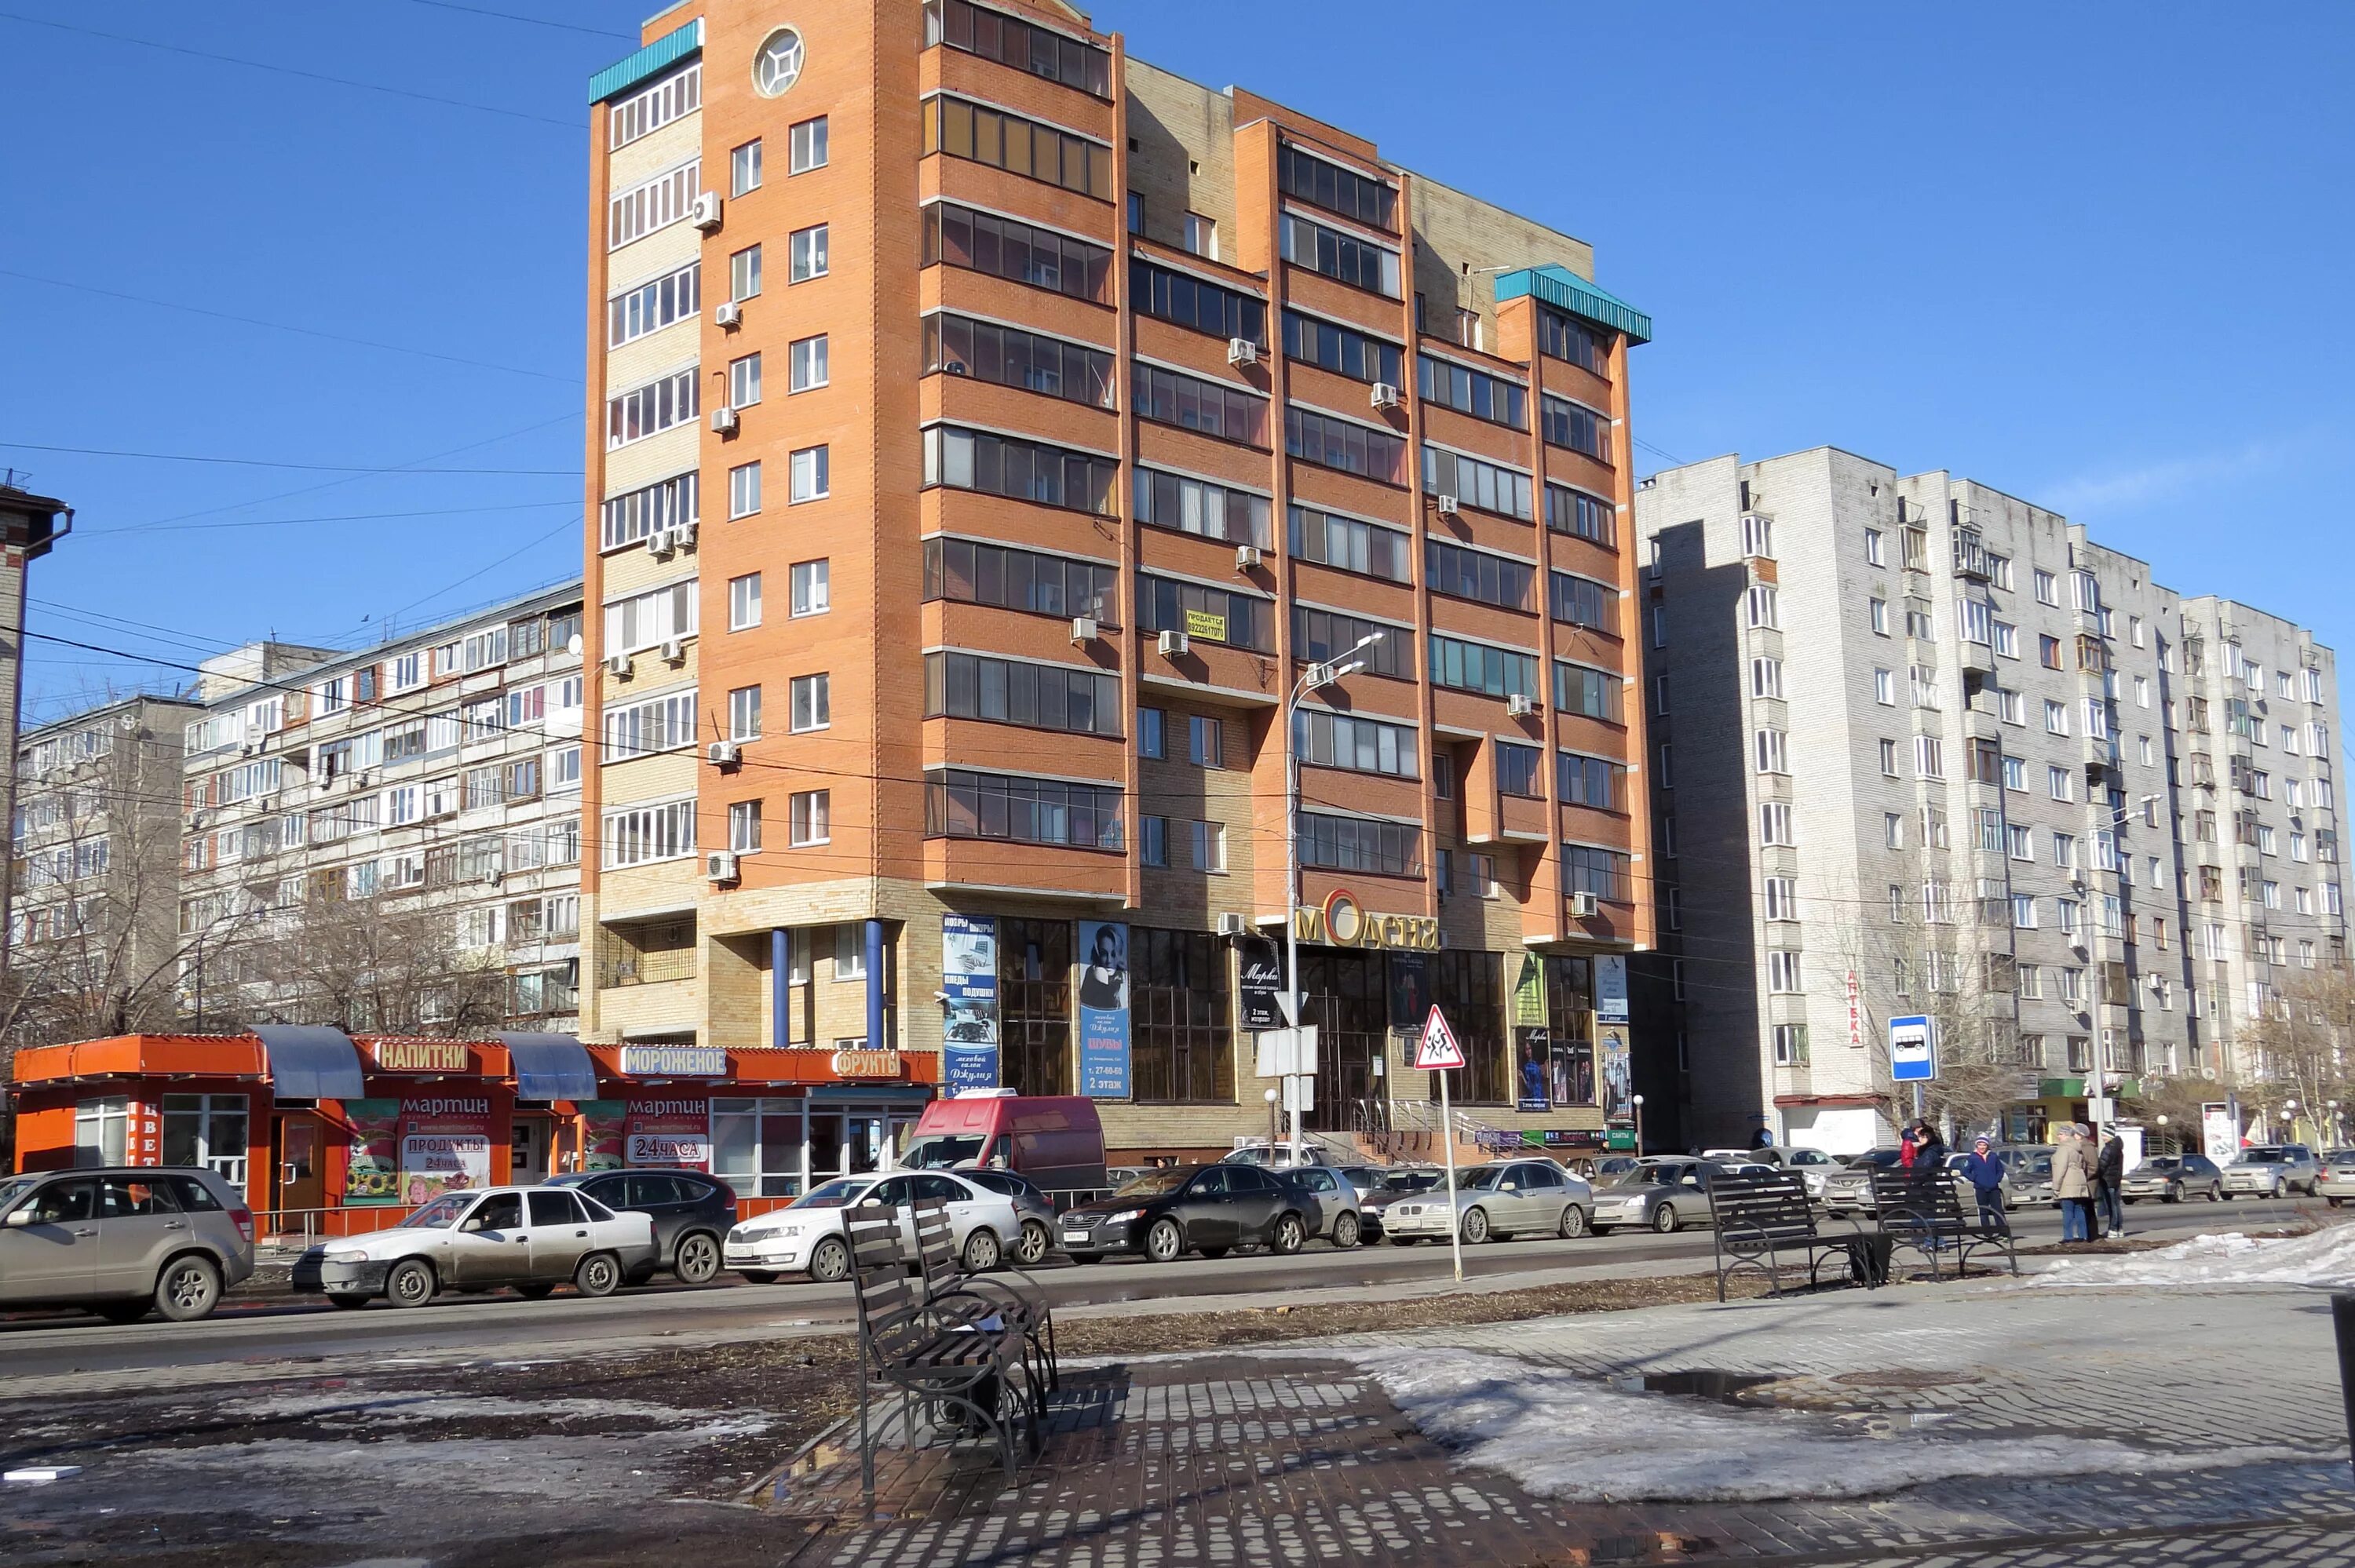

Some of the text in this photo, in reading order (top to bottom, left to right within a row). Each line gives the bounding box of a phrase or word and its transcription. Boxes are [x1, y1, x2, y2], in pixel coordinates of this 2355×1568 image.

[1188, 613, 1224, 625] ПРОДАЕТСЯ
[944, 975, 969, 985] ПЛЕДЫ
[962, 987, 994, 997] ПОДУШКИ
[1848, 969, 1860, 1044] АПТЕКА
[1088, 1037, 1123, 1050] ШУБЫ
[382, 1044, 466, 1069] НАПИТКИ
[626, 1049, 725, 1073] МОРОЖЕНОЕ
[838, 1052, 901, 1074] ФРУКТЫ
[950, 1068, 992, 1082] Джулия
[1090, 1077, 1122, 1089] 2 этаж
[402, 1098, 490, 1117] мартин
[628, 1099, 706, 1118] мартин
[408, 1139, 485, 1153] ПРОДУКТЫ
